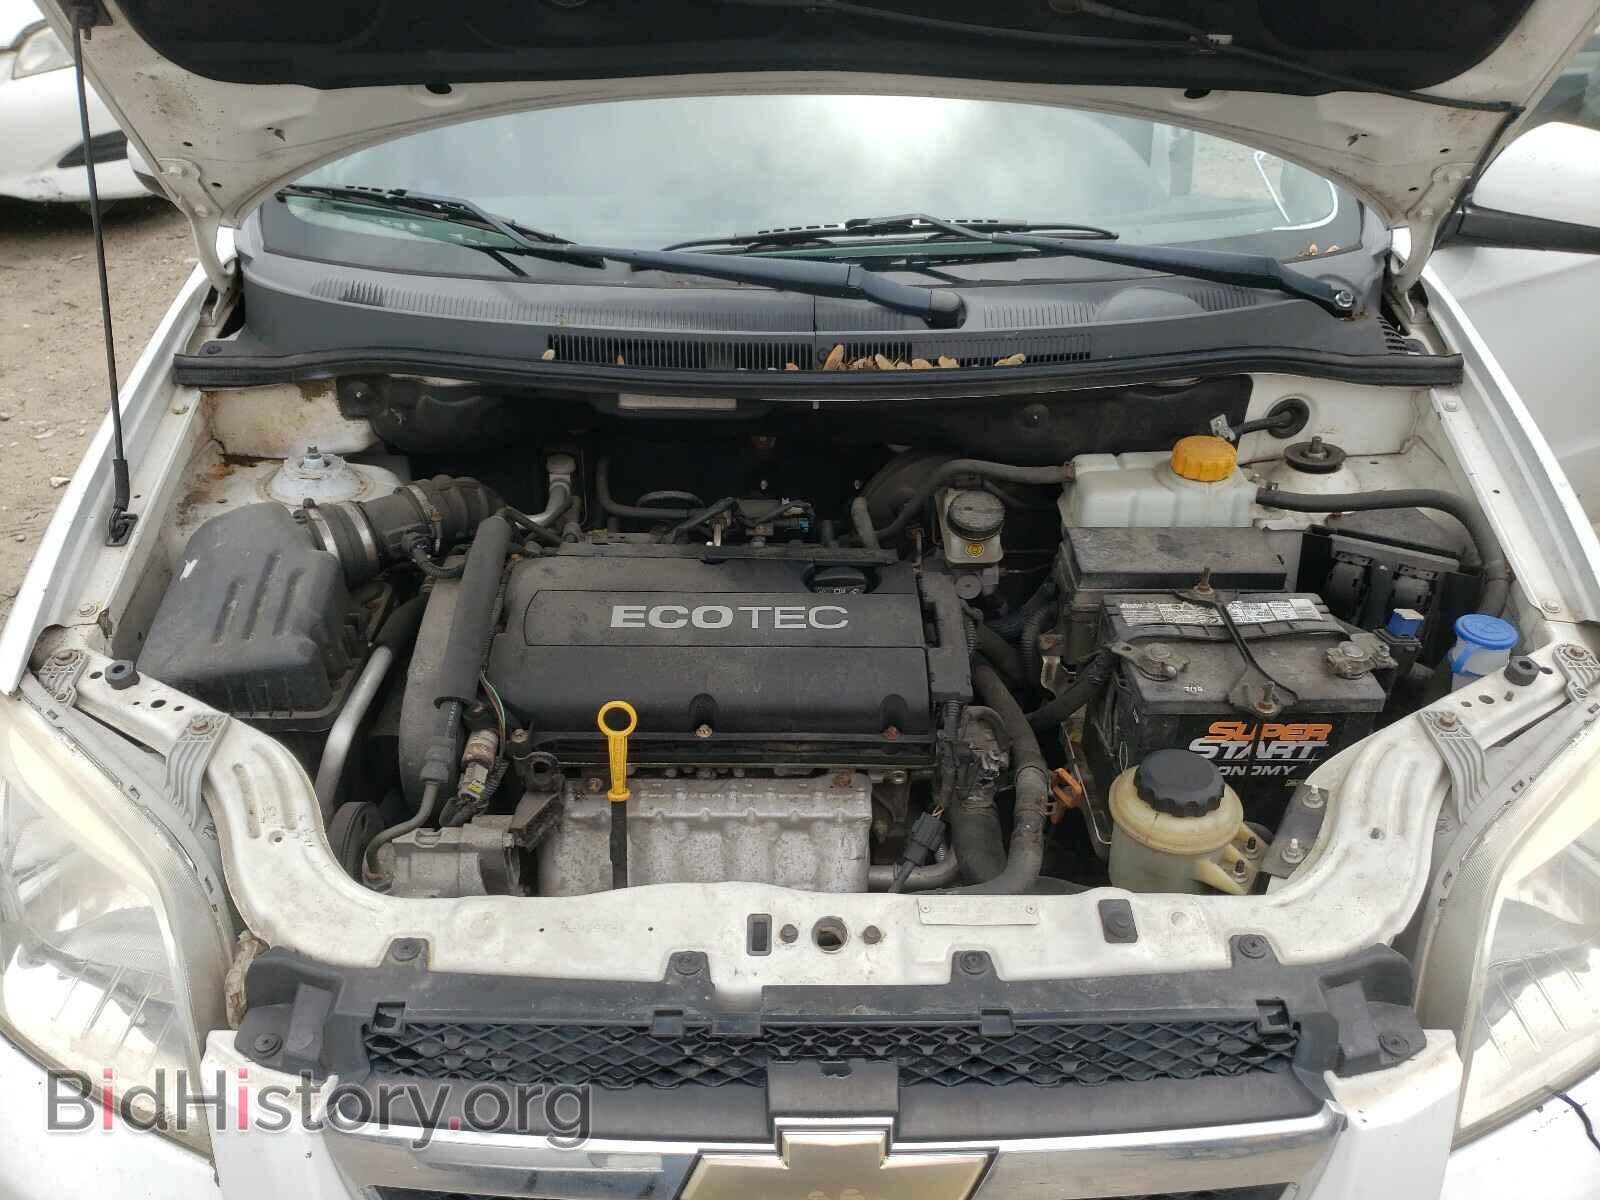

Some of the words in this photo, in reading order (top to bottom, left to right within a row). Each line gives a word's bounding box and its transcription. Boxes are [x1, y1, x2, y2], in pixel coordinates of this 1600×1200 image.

[609, 605, 849, 630] ECOTEC
[1204, 721, 1333, 741] SUPER
[1189, 738, 1329, 760] START
